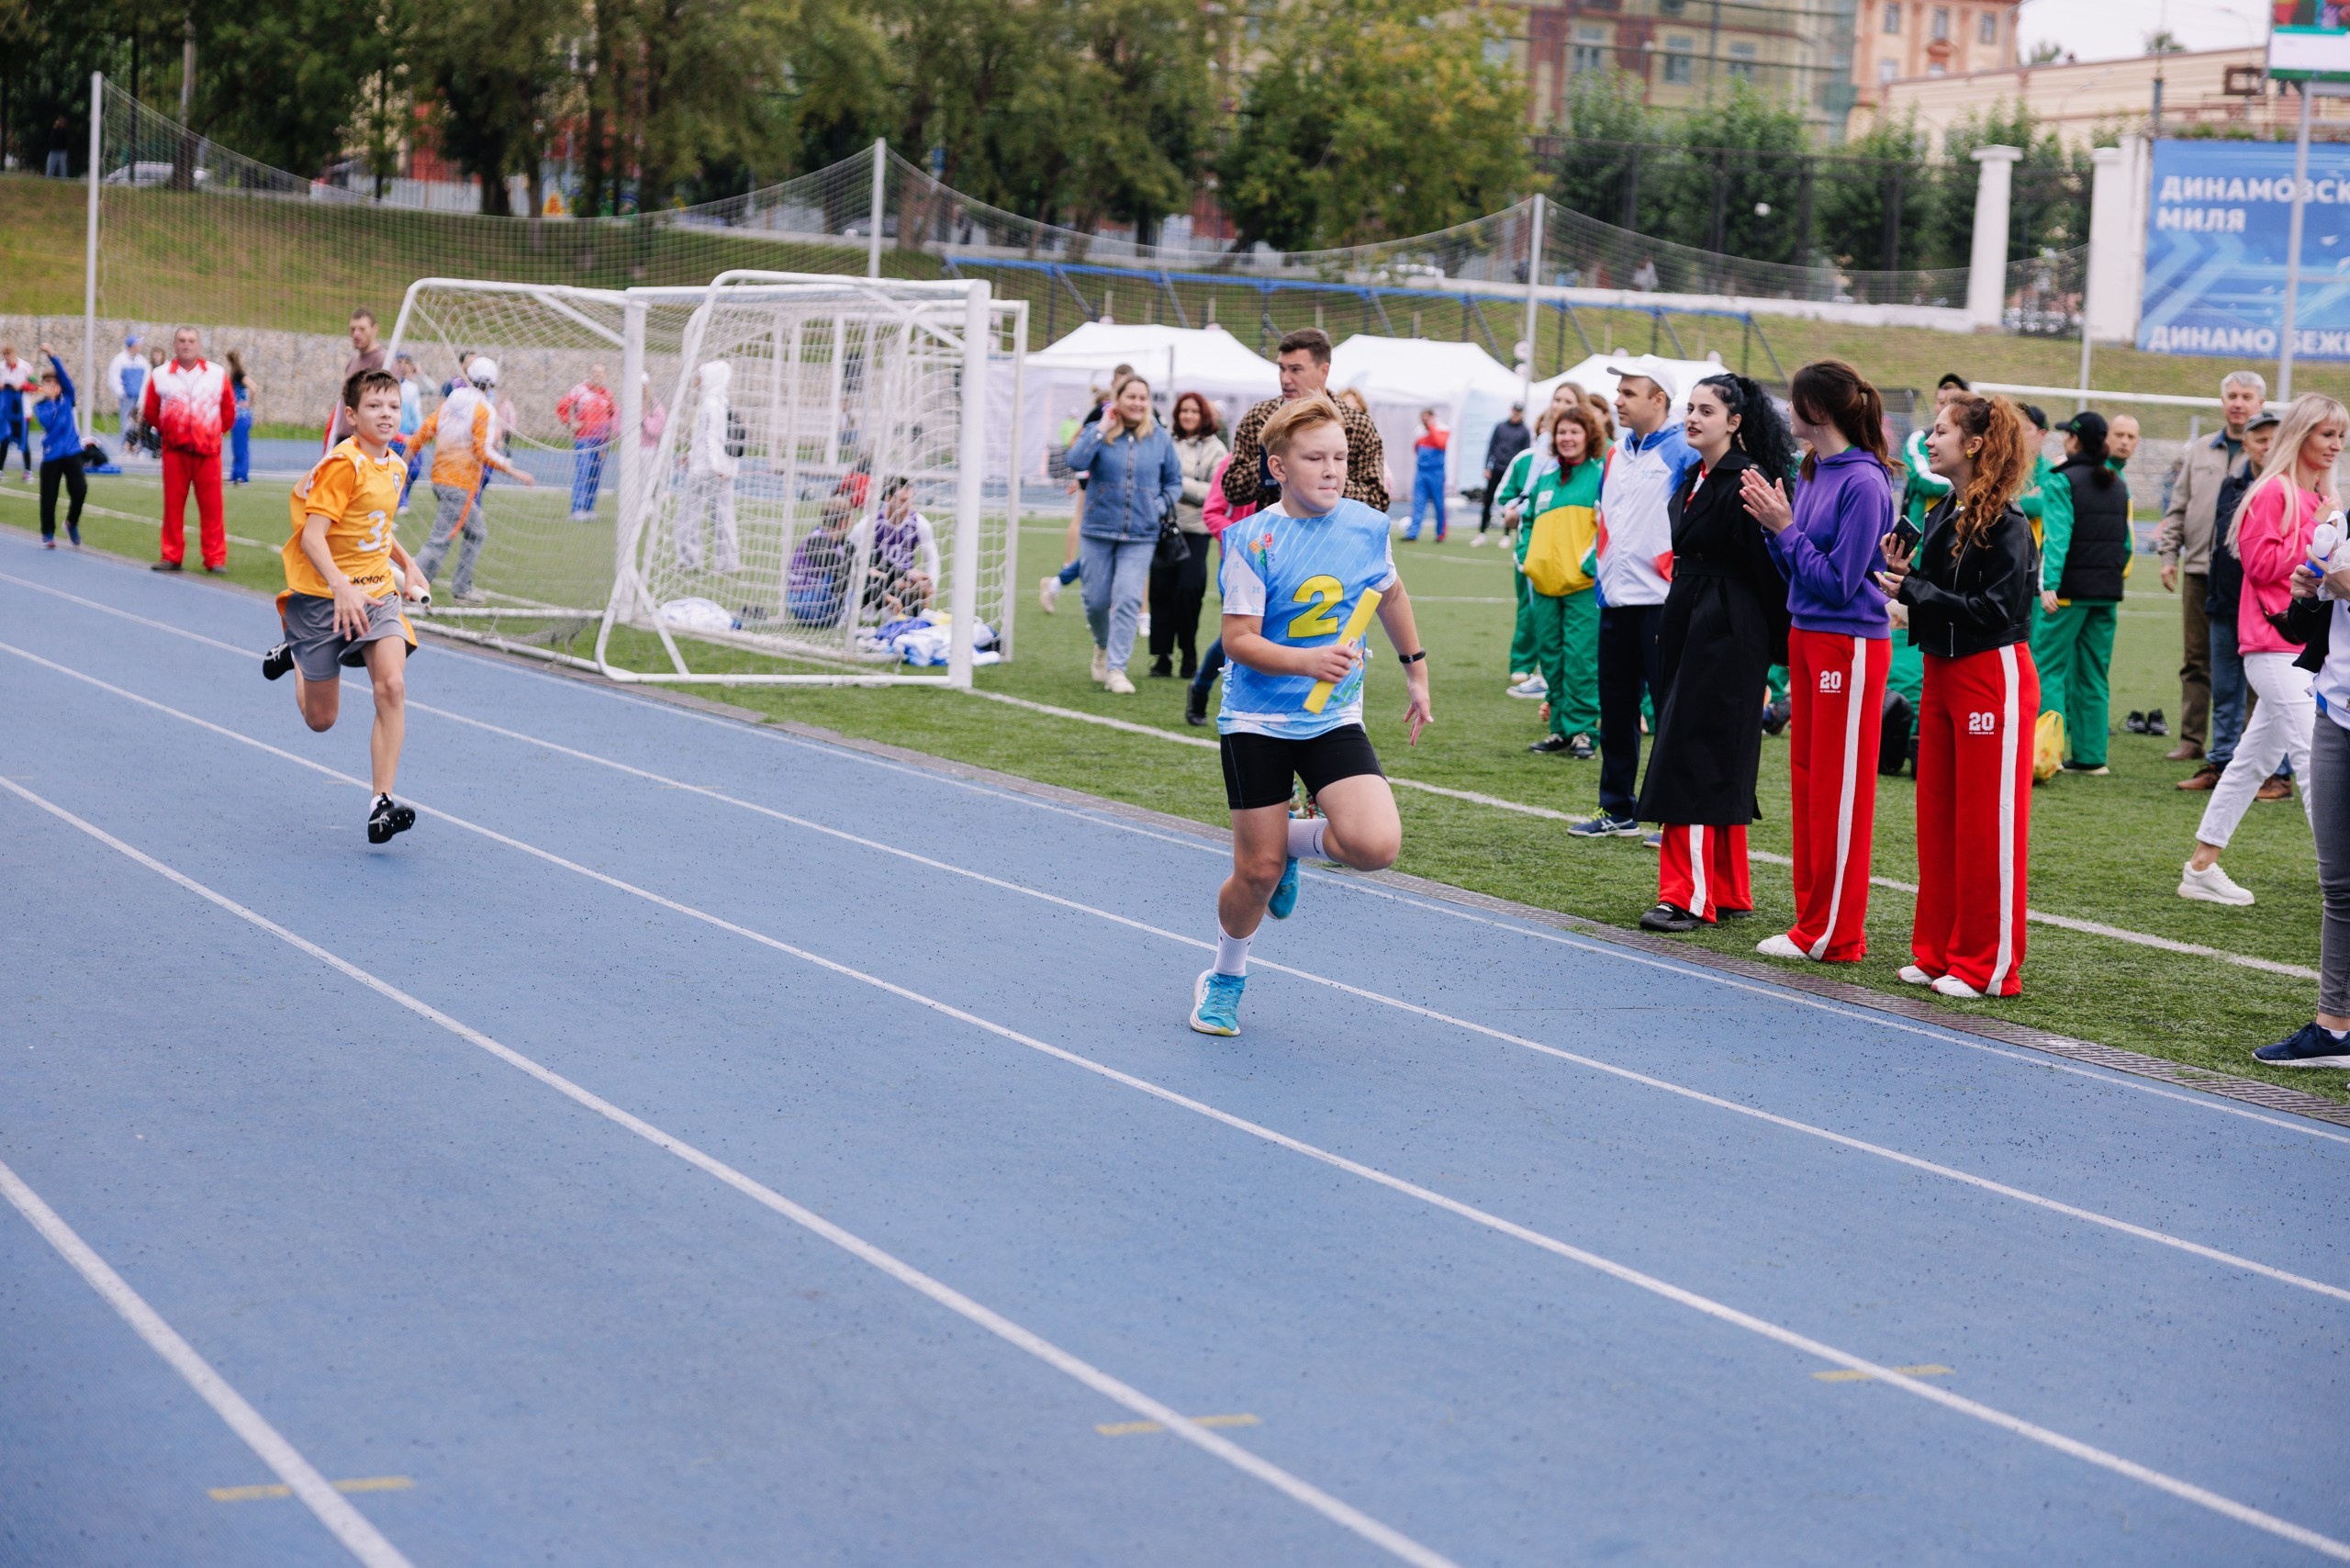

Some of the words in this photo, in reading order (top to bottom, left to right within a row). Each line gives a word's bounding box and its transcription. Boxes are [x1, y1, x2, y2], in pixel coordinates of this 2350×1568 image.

[2157, 207, 2246, 232] МИЛЯ
[2147, 325, 2277, 353] ДИНАМО
[1287, 574, 1344, 638] 2
[1819, 670, 1841, 689] 20
[1968, 711, 1995, 732] 20
